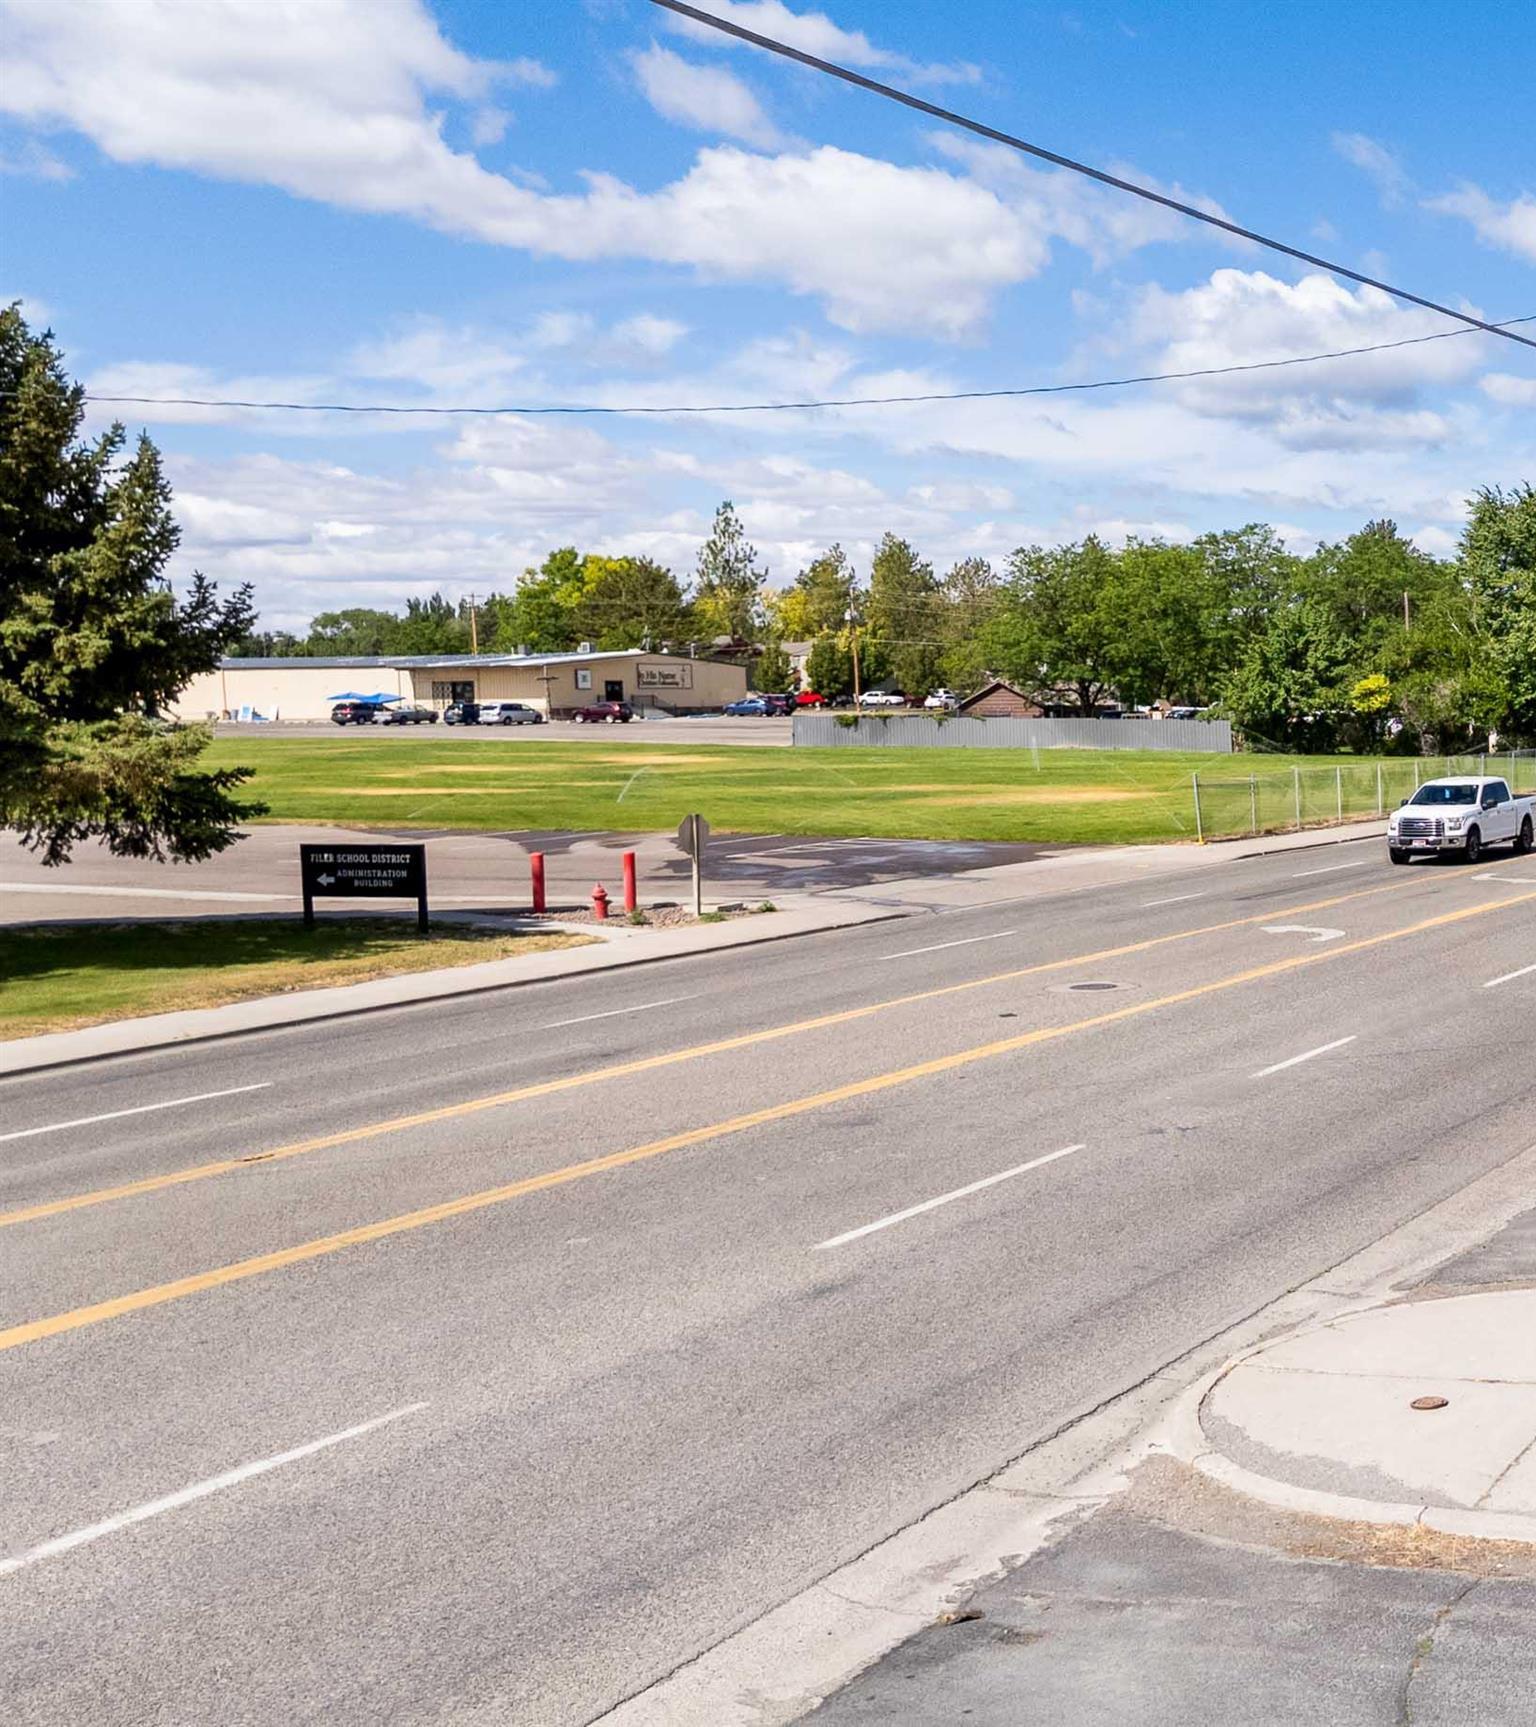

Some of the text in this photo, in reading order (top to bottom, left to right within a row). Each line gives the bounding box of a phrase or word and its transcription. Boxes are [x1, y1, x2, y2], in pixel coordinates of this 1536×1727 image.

[310, 853, 411, 864] FILER SCHOOL DISTRICT
[336, 869, 408, 879] ADMINISTRATION
[354, 879, 394, 888] BUILDING
